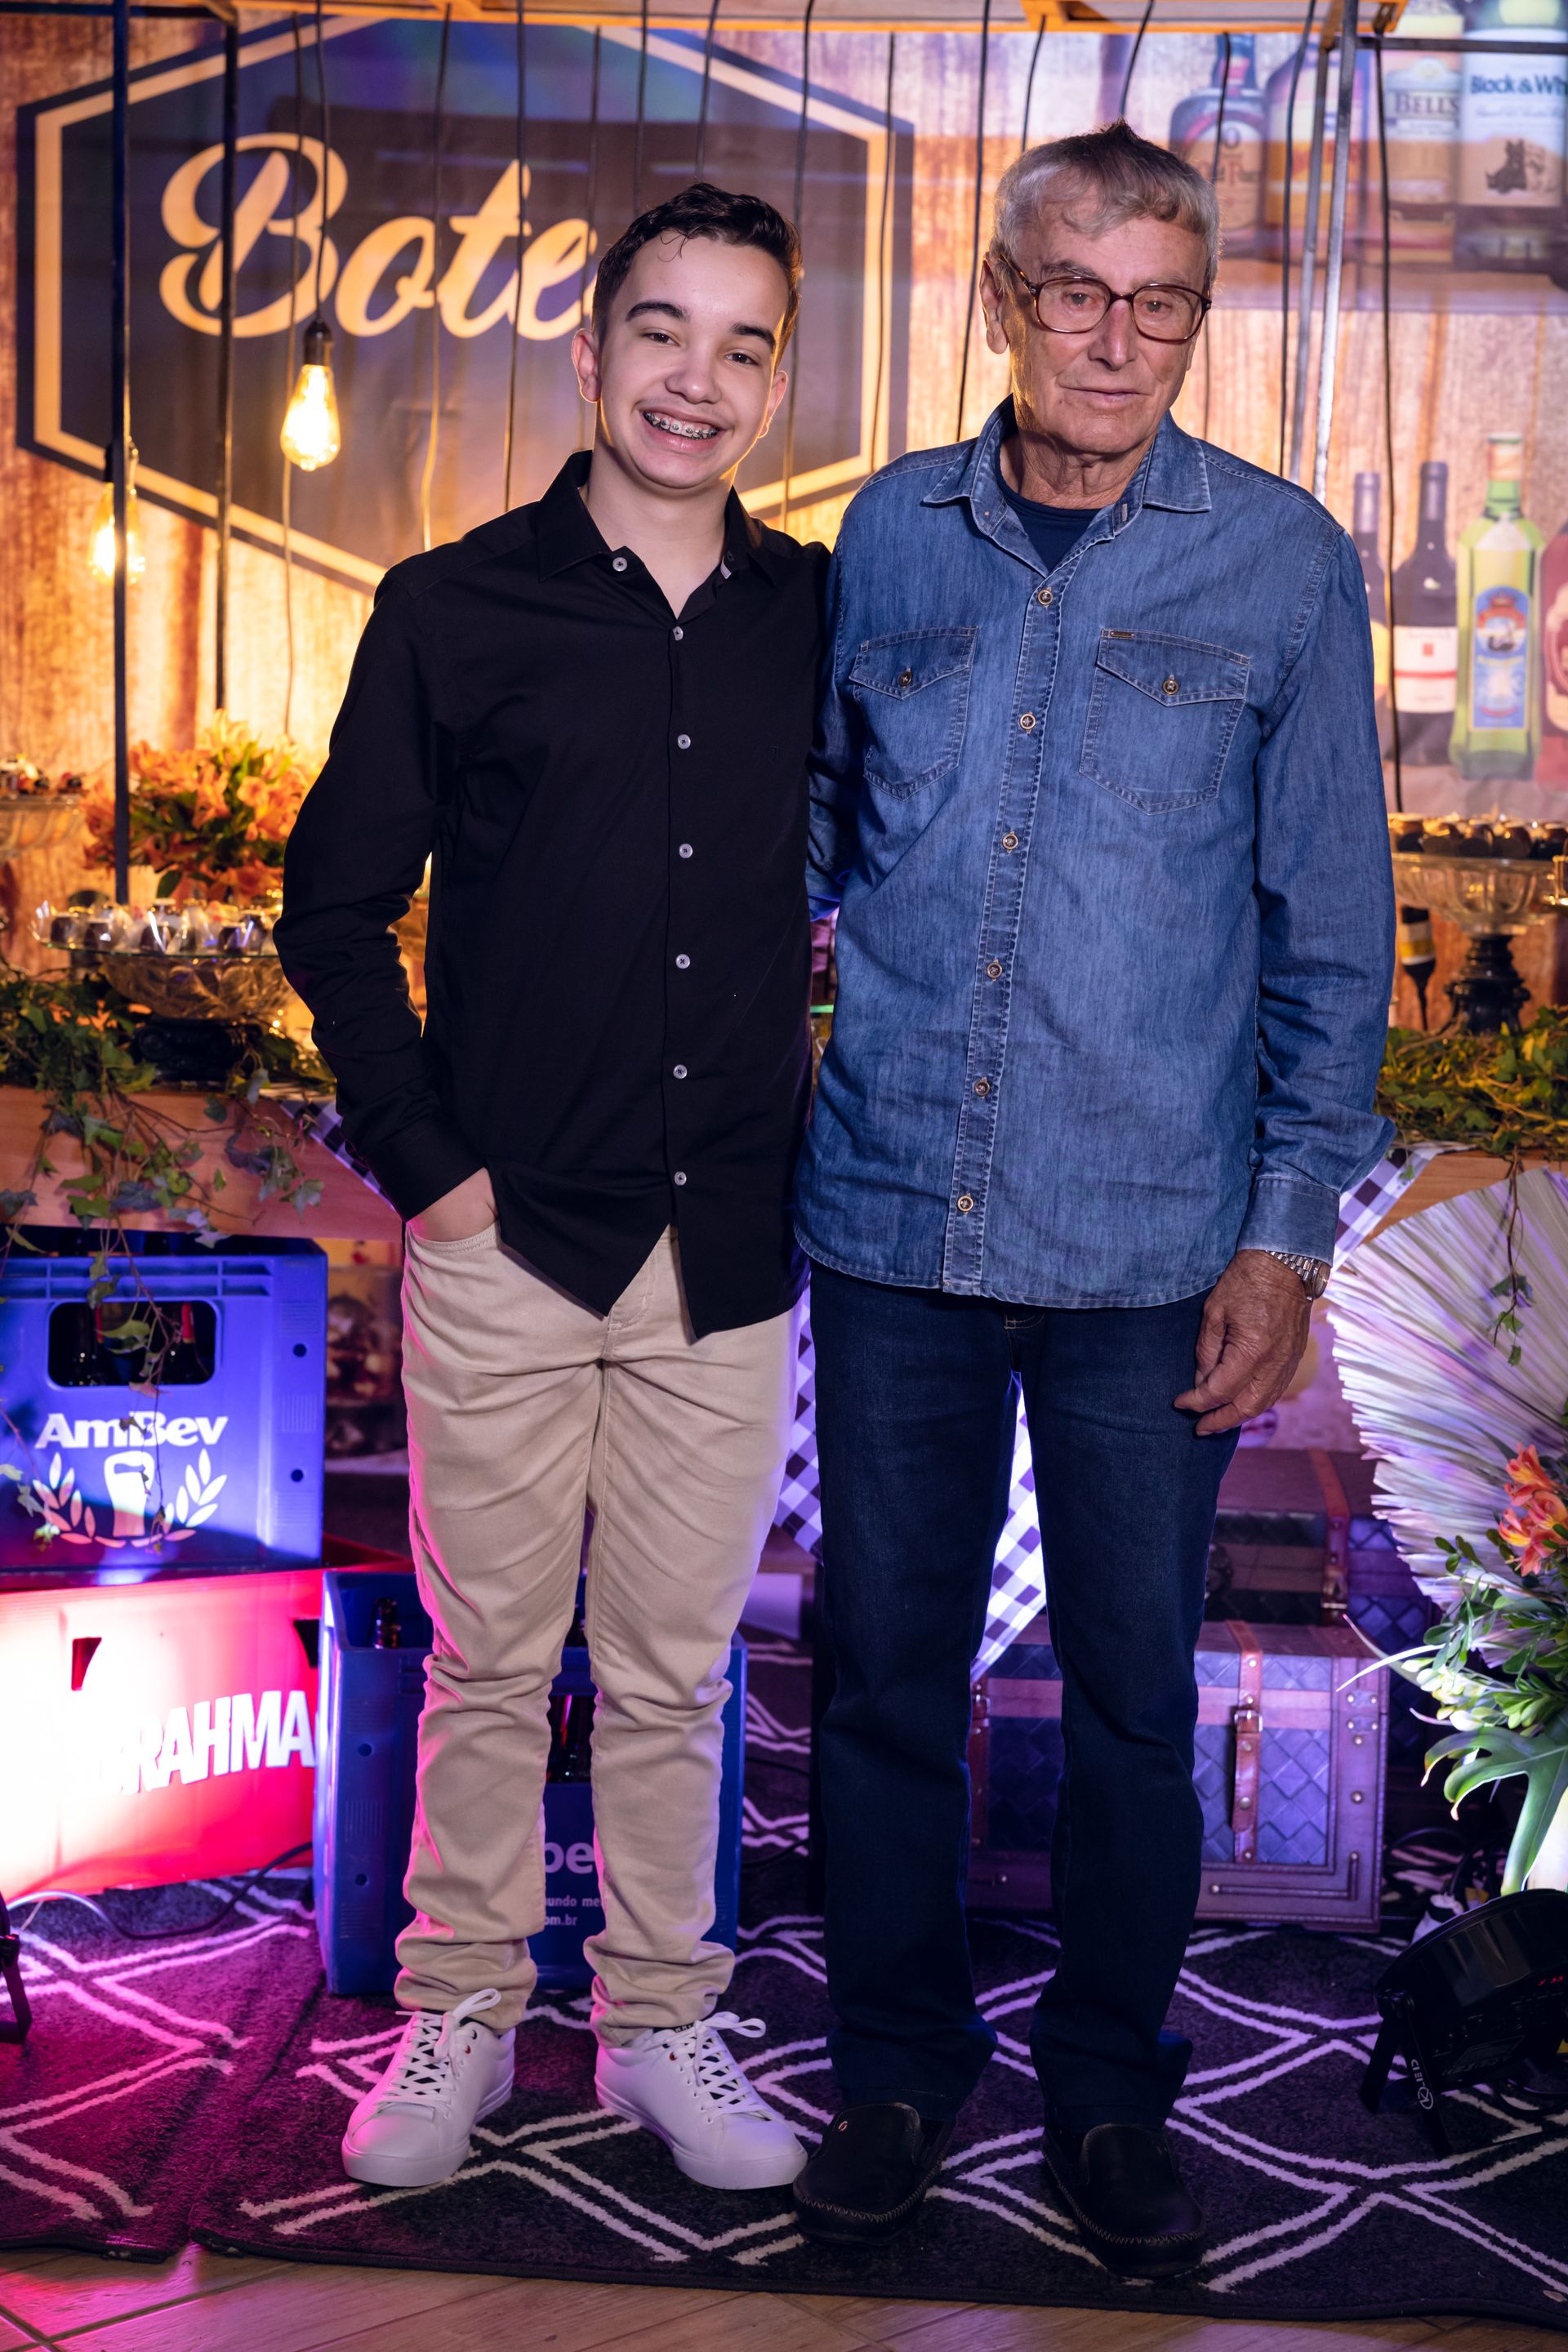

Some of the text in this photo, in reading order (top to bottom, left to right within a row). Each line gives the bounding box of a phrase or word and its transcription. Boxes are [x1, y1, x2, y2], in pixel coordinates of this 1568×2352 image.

[159, 132, 597, 341] Bote
[35, 1411, 229, 1449] AmBev
[108, 1690, 317, 1795] RAHMA
[545, 1895, 577, 1908] undo
